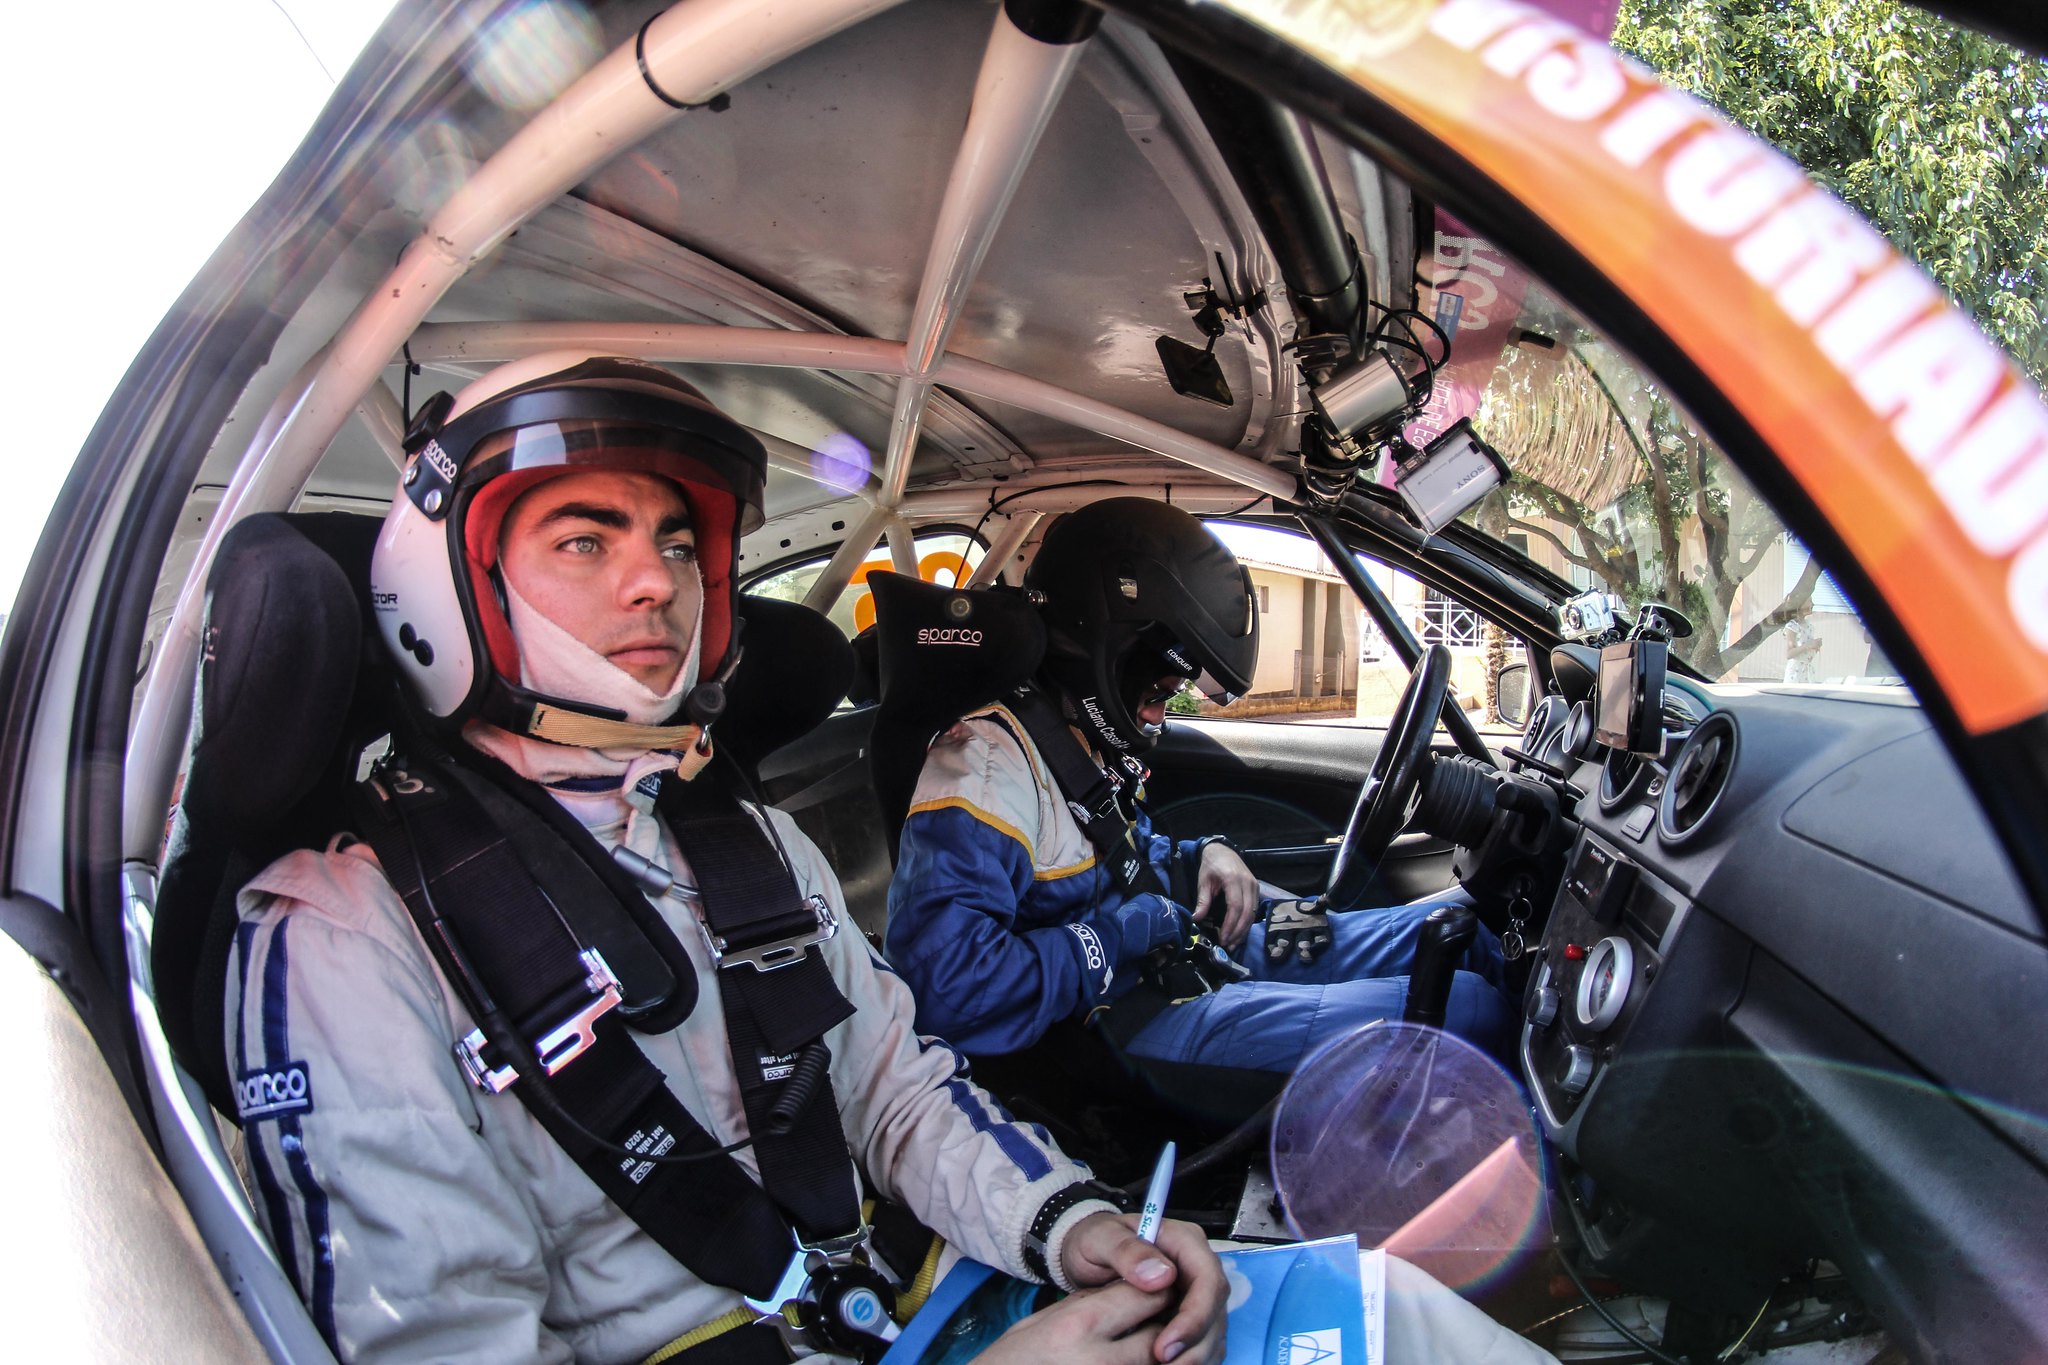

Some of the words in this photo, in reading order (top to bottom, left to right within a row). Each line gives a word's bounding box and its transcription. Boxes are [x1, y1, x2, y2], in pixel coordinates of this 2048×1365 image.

[425, 438, 458, 482] sparco
[1455, 464, 1486, 489] SONY
[918, 628, 983, 645] sparco
[1167, 648, 1193, 672] CONQUER
[1082, 696, 1107, 728] Luciano
[1068, 923, 1102, 969] parco
[238, 1068, 307, 1116] parco
[624, 1129, 645, 1151] 2020
[650, 1125, 665, 1140] not
[636, 1138, 674, 1180] spco
